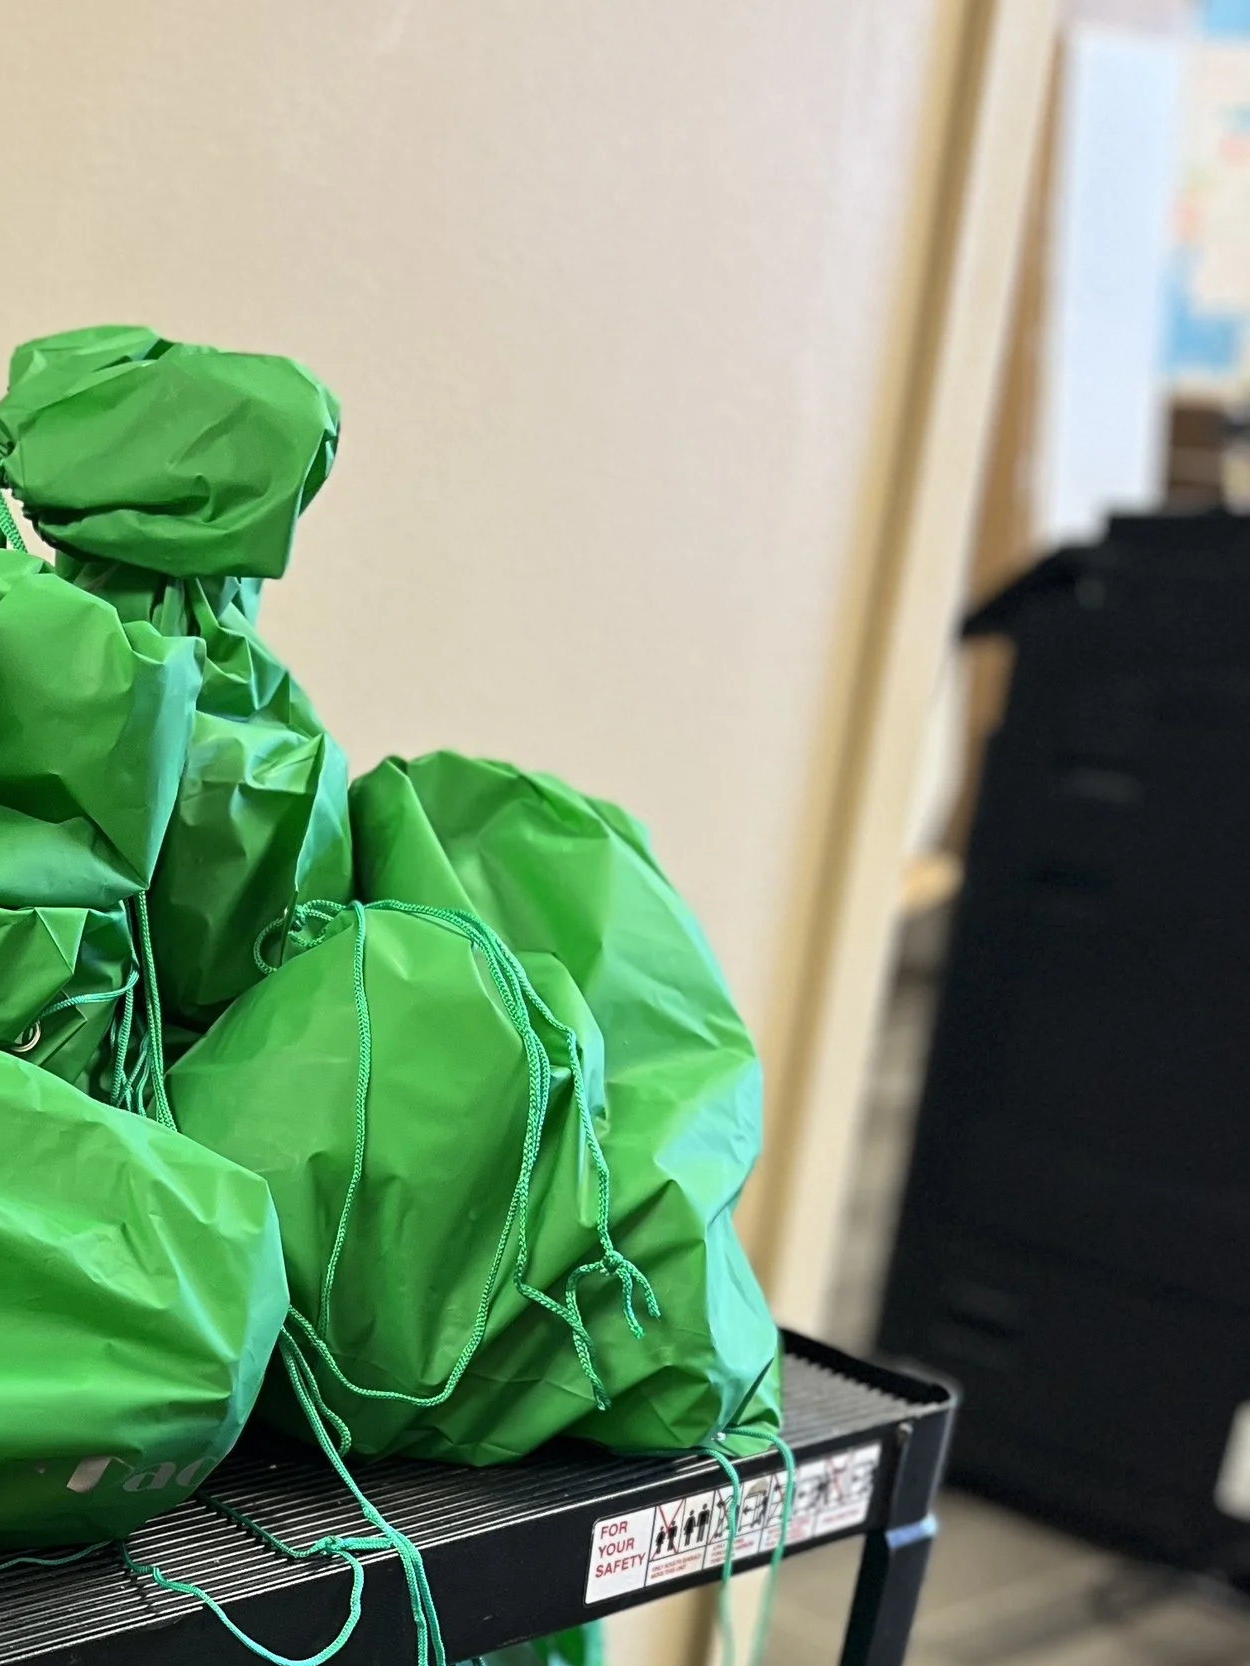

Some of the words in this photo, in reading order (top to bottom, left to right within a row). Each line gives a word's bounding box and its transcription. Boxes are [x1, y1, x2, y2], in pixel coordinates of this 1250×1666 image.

[600, 1520, 628, 1539] FOR
[598, 1537, 635, 1558] YOUR
[595, 1552, 646, 1578] SAFETY
